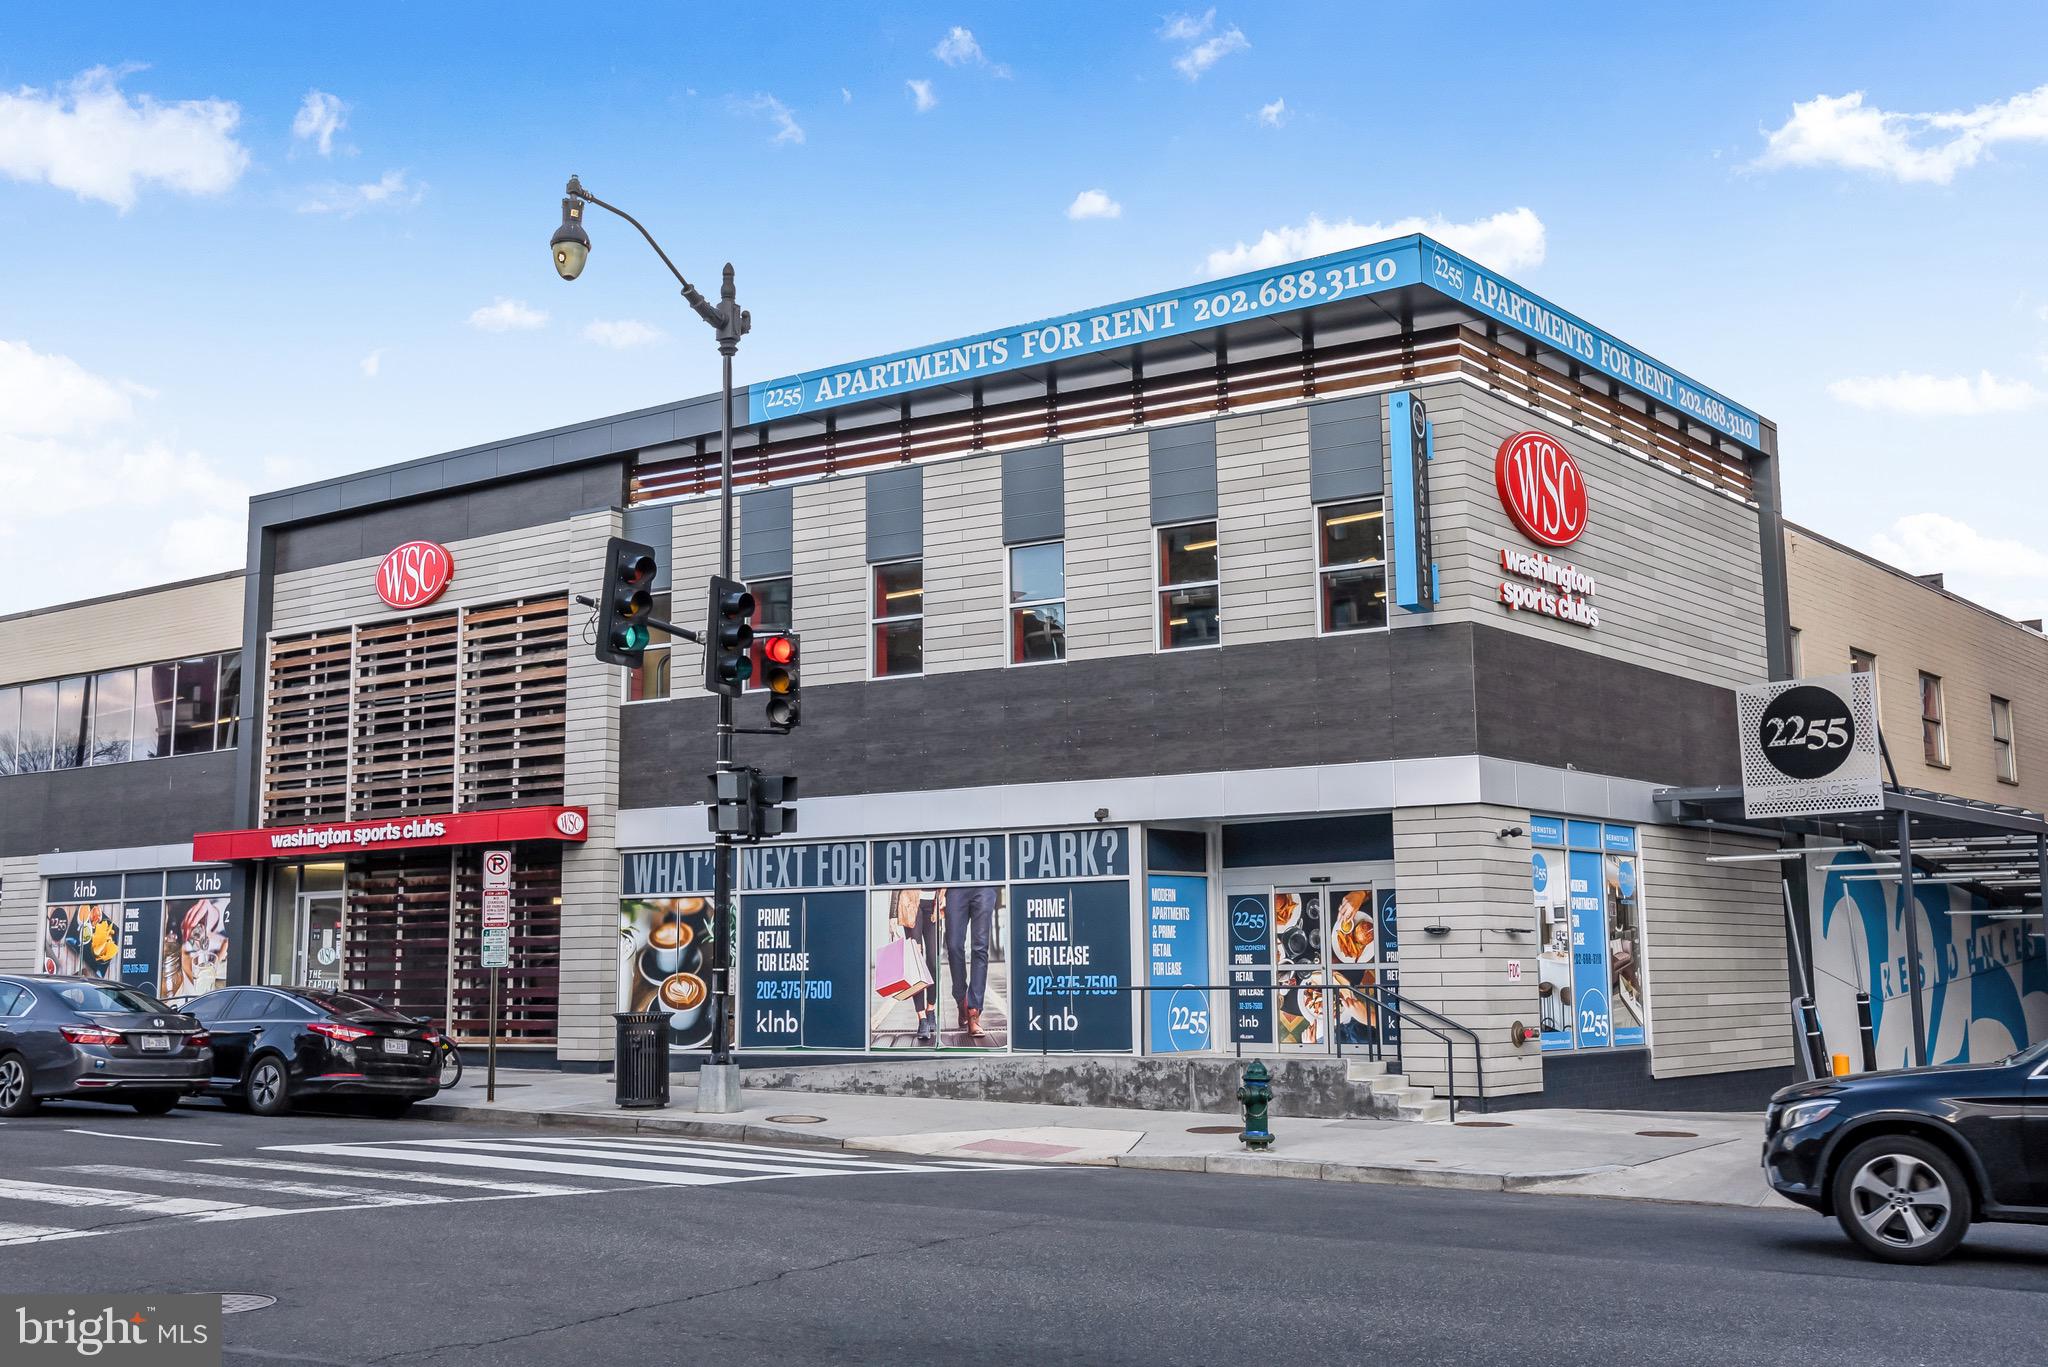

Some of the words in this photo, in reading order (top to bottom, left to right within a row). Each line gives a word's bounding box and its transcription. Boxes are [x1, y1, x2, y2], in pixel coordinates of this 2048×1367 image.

[766, 386, 802, 408] 2255
[815, 337, 1008, 403] APARTMENTS
[1021, 318, 1081, 360] FOR
[1090, 299, 1180, 345] RENT
[1193, 257, 1397, 322] 202.688.3110
[1434, 254, 1463, 291] 2255
[1472, 274, 1594, 360] APARTMENTS
[1600, 340, 1631, 381] FOR
[1634, 357, 1674, 401] RENT
[1678, 386, 1753, 440] 202.688.3110
[1514, 441, 1578, 535] WSC
[1417, 442, 1429, 599] APARTMENTS
[384, 545, 436, 603] WSC
[1502, 548, 1596, 596] washington
[1502, 582, 1557, 615] sports
[1558, 593, 1600, 627] clubs
[1766, 715, 1849, 750] 2255
[1765, 783, 1860, 801] RESIDENCES
[559, 813, 583, 833] WSC
[271, 827, 351, 849] washington
[353, 822, 401, 845] sports
[403, 818, 445, 838] clubs
[632, 851, 716, 895] WHAT'
[743, 848, 808, 890] NEXT
[817, 842, 865, 887] FOR
[885, 837, 991, 884] GLOVER
[1018, 829, 1119, 879] PARK?
[73, 879, 97, 898] klnb
[195, 872, 222, 892] klnb
[1151, 888, 1177, 902] MODERN
[757, 908, 790, 927] PRIME
[1027, 898, 1065, 918] PRIME
[1152, 906, 1190, 921] APARTMENTS
[50, 917, 67, 932] 2255
[1234, 911, 1265, 929] 2255
[757, 931, 791, 950] RETAIL
[1027, 923, 1068, 942] RETAIL
[1152, 925, 1158, 939] &
[1158, 925, 1177, 939] PRIME
[1573, 932, 1585, 946] EASE
[1027, 946, 1050, 966] FOR
[1053, 945, 1089, 966] LEASE
[1152, 943, 1172, 957] RETAIL
[1234, 944, 1266, 952] WISCONSIN
[1386, 951, 1399, 963] PRI
[757, 953, 777, 972] FOR
[778, 952, 809, 972] LEASE
[1153, 962, 1164, 976] FOR
[1165, 962, 1182, 976] LEASE
[1235, 953, 1253, 965] PRIME
[1880, 922, 2036, 1000] RESIDENCES
[309, 969, 322, 979] THE
[1235, 971, 1254, 982] RETAIL
[1386, 969, 1399, 981] RET
[1508, 963, 1520, 978] FDC
[756, 980, 832, 1000] 202-3757500
[1028, 975, 1118, 996] 202-375-7500
[1248, 989, 1264, 997] LEASE
[756, 1010, 799, 1033] klnb
[1028, 1006, 1079, 1032] knb
[1171, 1006, 1208, 1035] 2255
[1581, 1010, 1609, 1037] 2255
